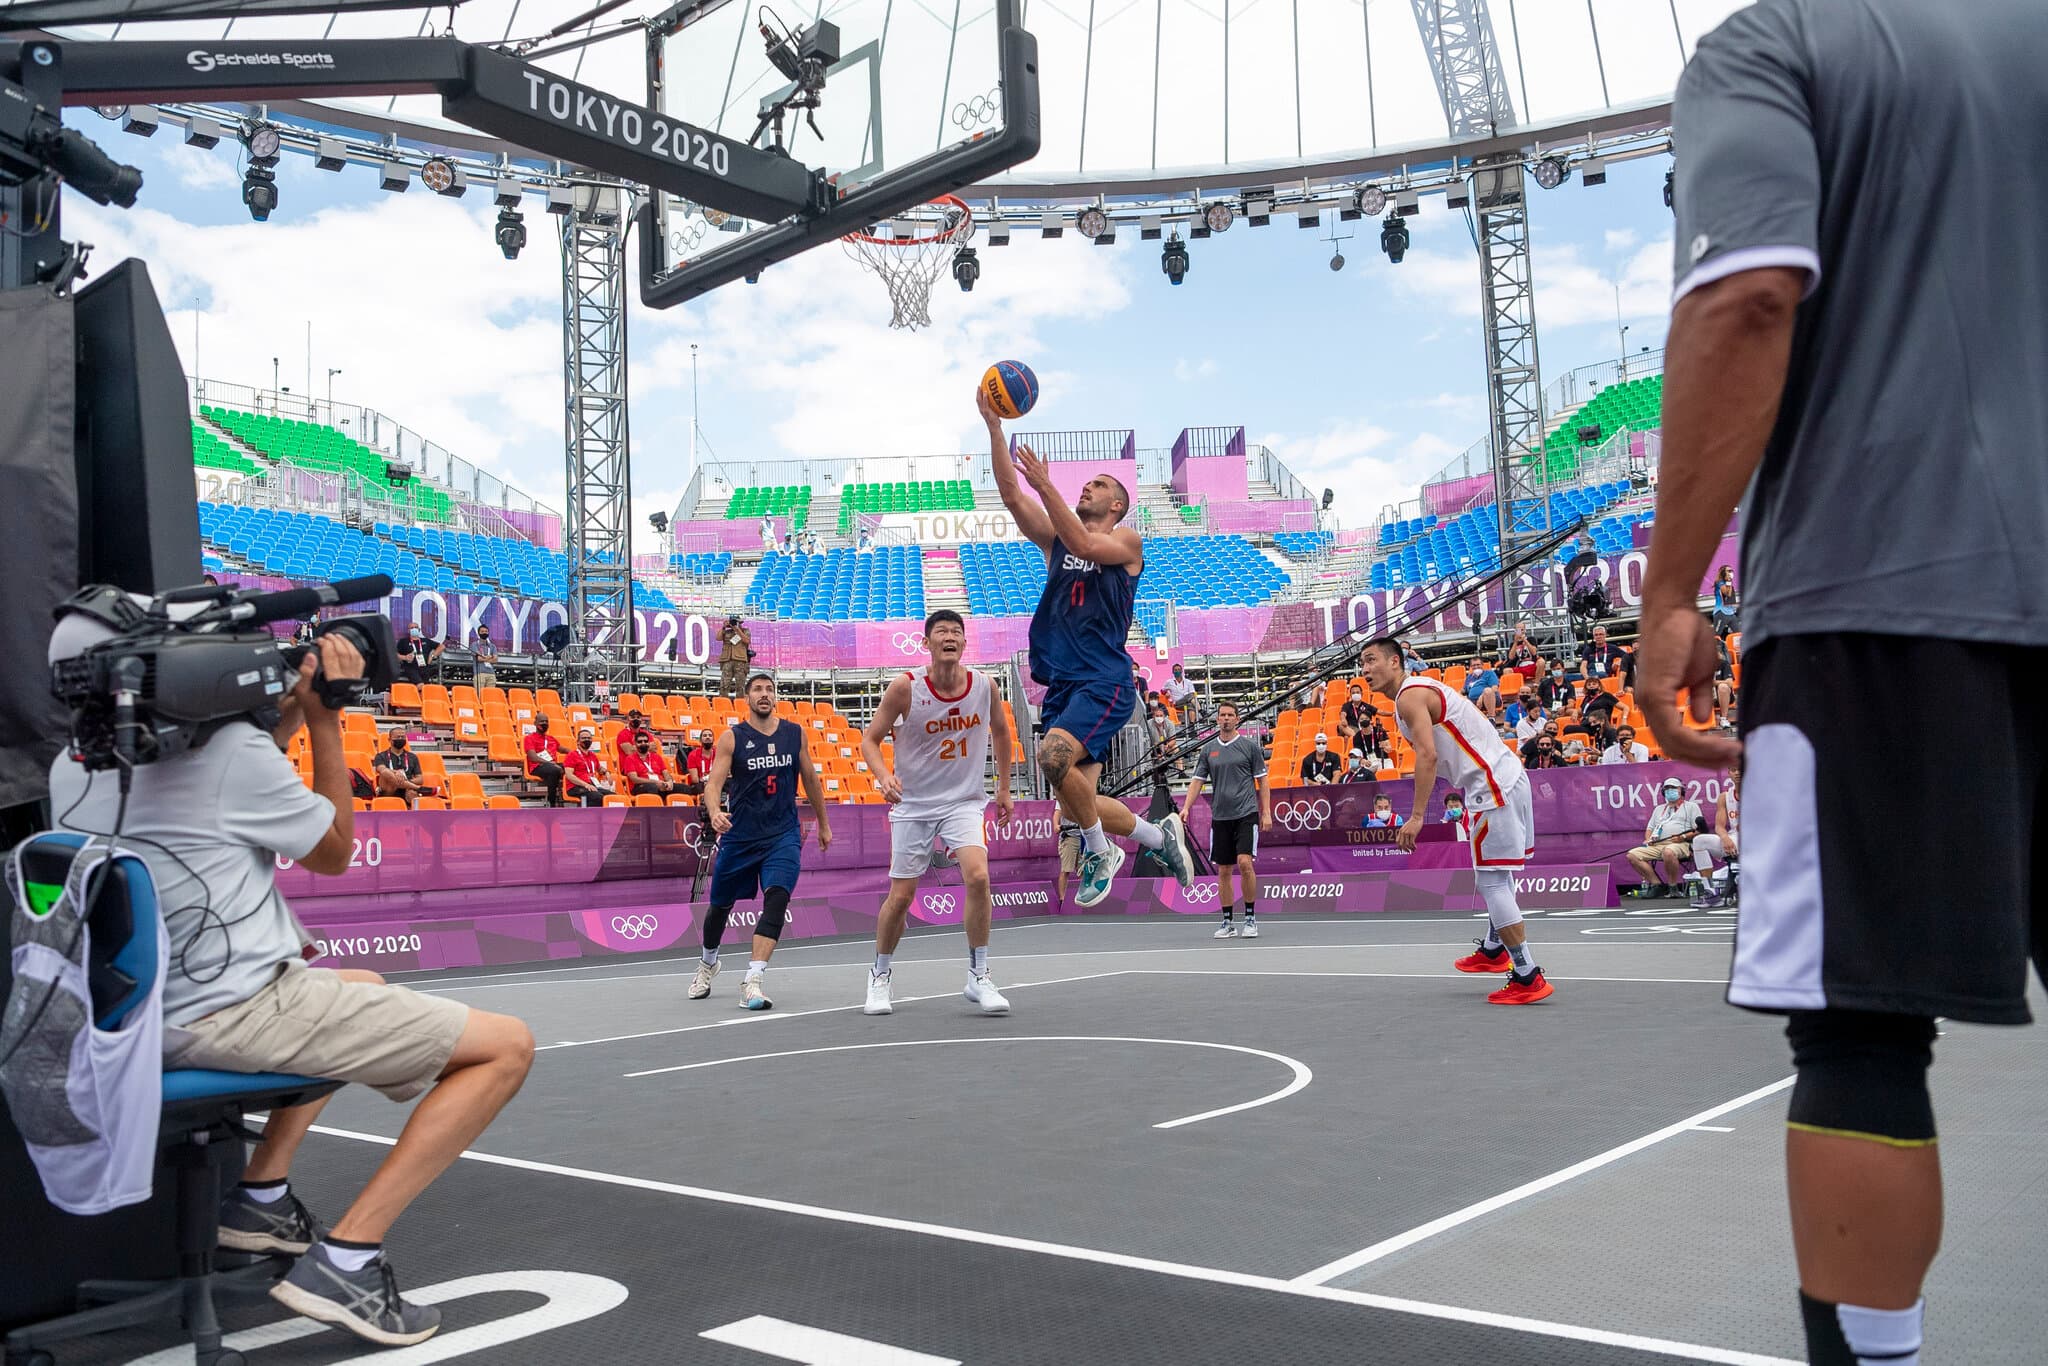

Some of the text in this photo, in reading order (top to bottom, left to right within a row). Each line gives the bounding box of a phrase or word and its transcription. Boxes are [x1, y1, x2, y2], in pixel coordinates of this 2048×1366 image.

[282, 52, 334, 67] Sports
[523, 71, 729, 177] TOKYO 2020
[913, 514, 1008, 541] TOKYO
[1313, 575, 1490, 647] TOKYO
[587, 604, 710, 665] 2020
[925, 713, 981, 735] CHINA
[939, 737, 968, 760] 21
[747, 753, 793, 771] SRBIJA
[767, 775, 777, 794] 5
[1591, 777, 1736, 810] TOKY 20
[985, 819, 1052, 841] KYO 2020
[1346, 829, 1385, 843] TOKYO
[348, 837, 382, 867] 20
[1352, 849, 1374, 857] United
[1375, 848, 1383, 857] by
[1263, 883, 1344, 899] TOKYO 2020
[1514, 876, 1591, 893] KYO 2020
[990, 891, 1049, 907] TOKYO 2020
[726, 911, 757, 928] KYO
[317, 934, 422, 957] OKYO 2020
